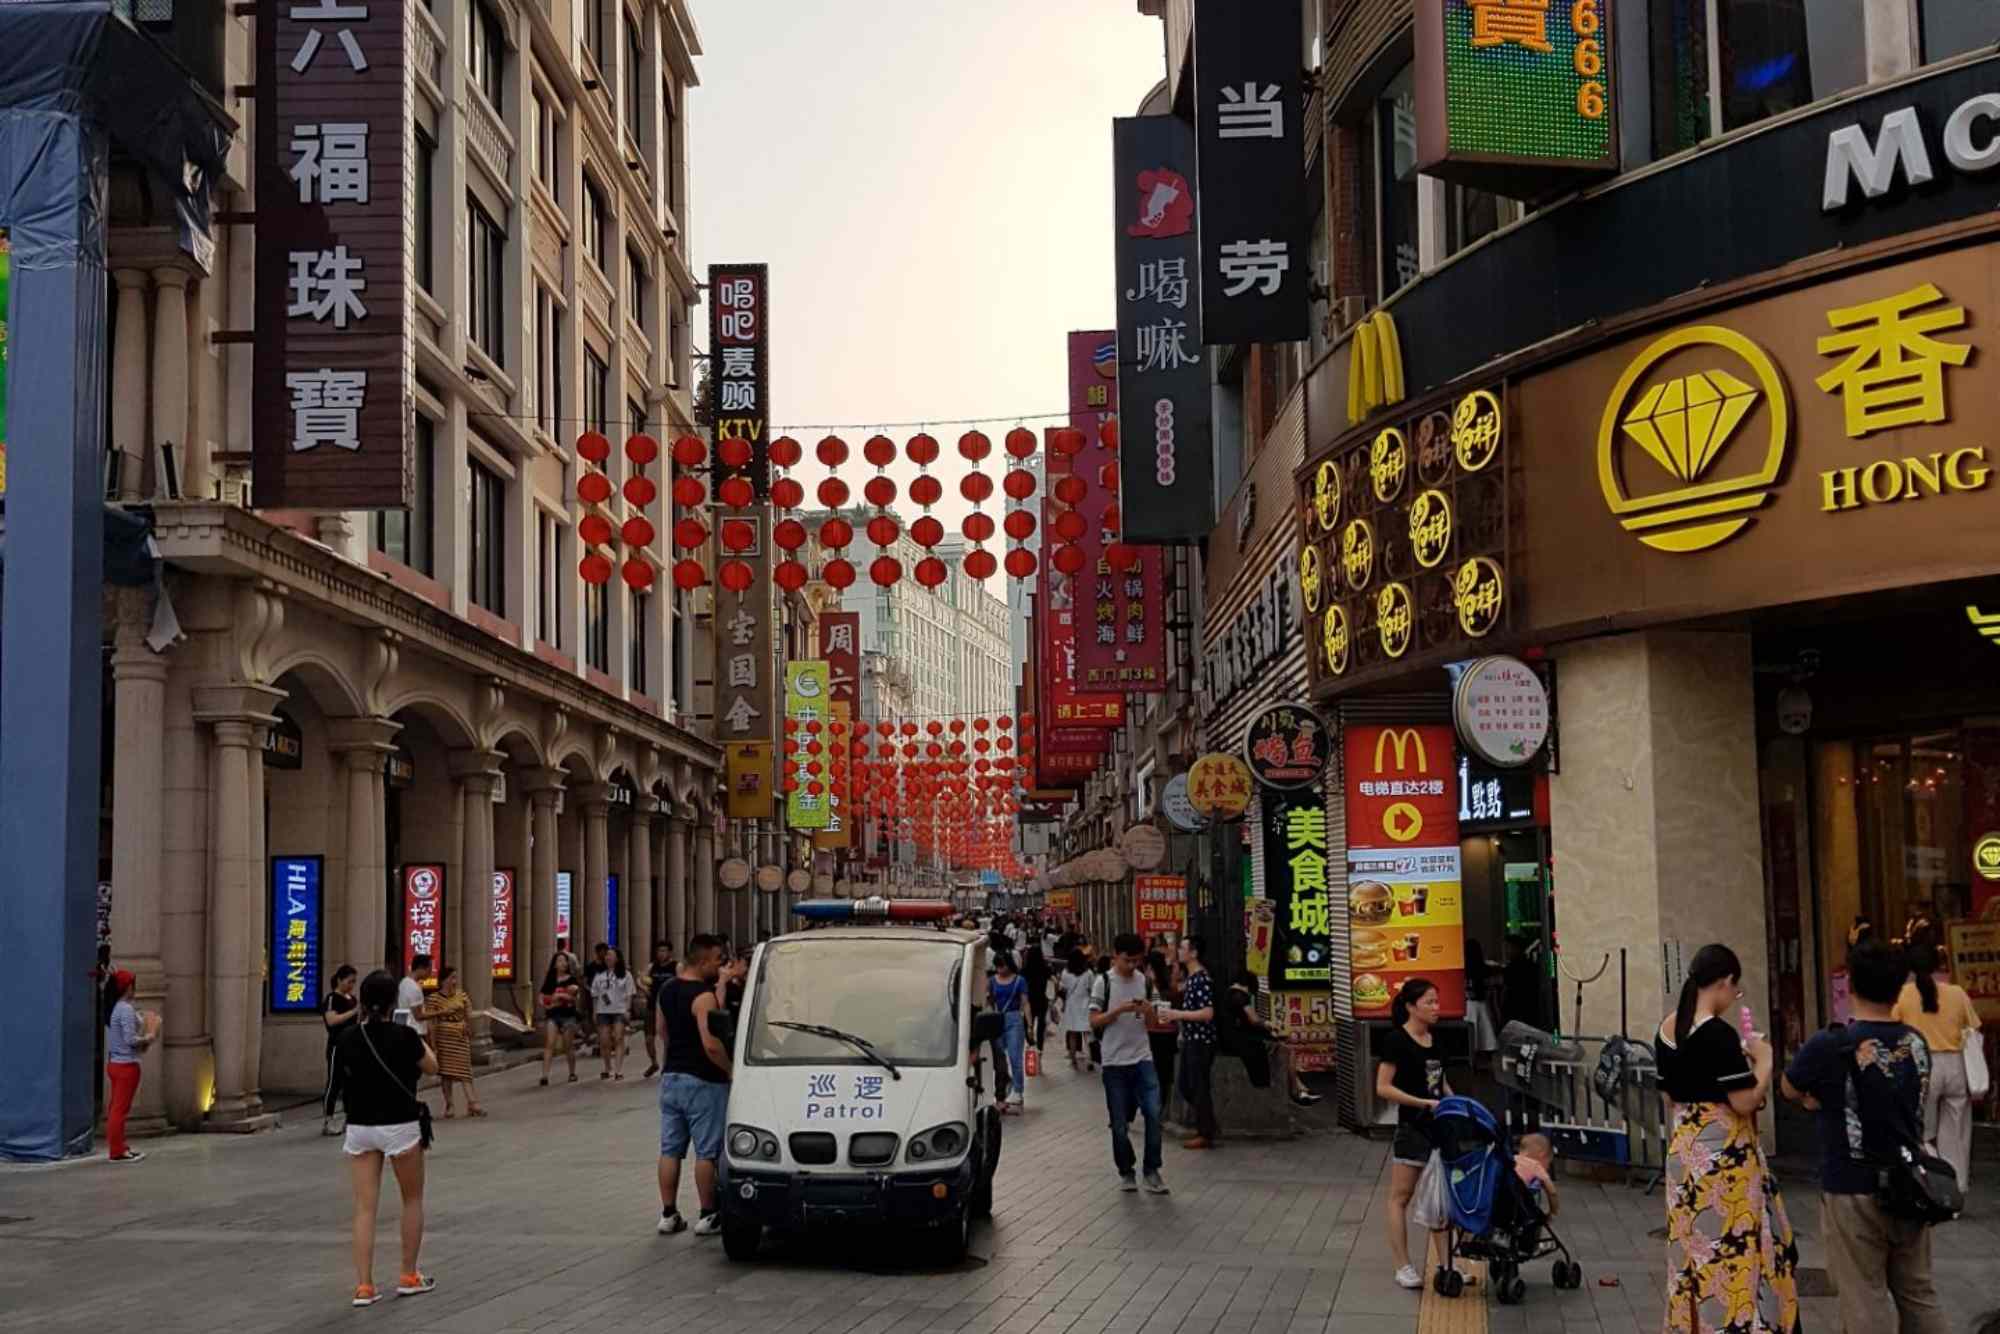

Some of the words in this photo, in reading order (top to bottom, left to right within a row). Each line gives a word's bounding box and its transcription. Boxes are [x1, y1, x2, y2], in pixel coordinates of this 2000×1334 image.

[1217, 81, 1290, 297] 当劳
[286, 0, 370, 452] 六福珠寶
[1125, 256, 1200, 373] 喝嘛
[1814, 282, 1973, 439] 香
[718, 418, 763, 441] KTV
[1820, 445, 1990, 513] HONG
[1096, 621, 1145, 644] 海鲜
[1056, 702, 1121, 720] 请上二楼
[1359, 779, 1444, 797] 电梯直达2楼
[287, 863, 307, 916] HLA
[1286, 804, 1330, 937] 美食城
[806, 1102, 884, 1119] Patrol
[807, 1073, 884, 1100] 巡逻
